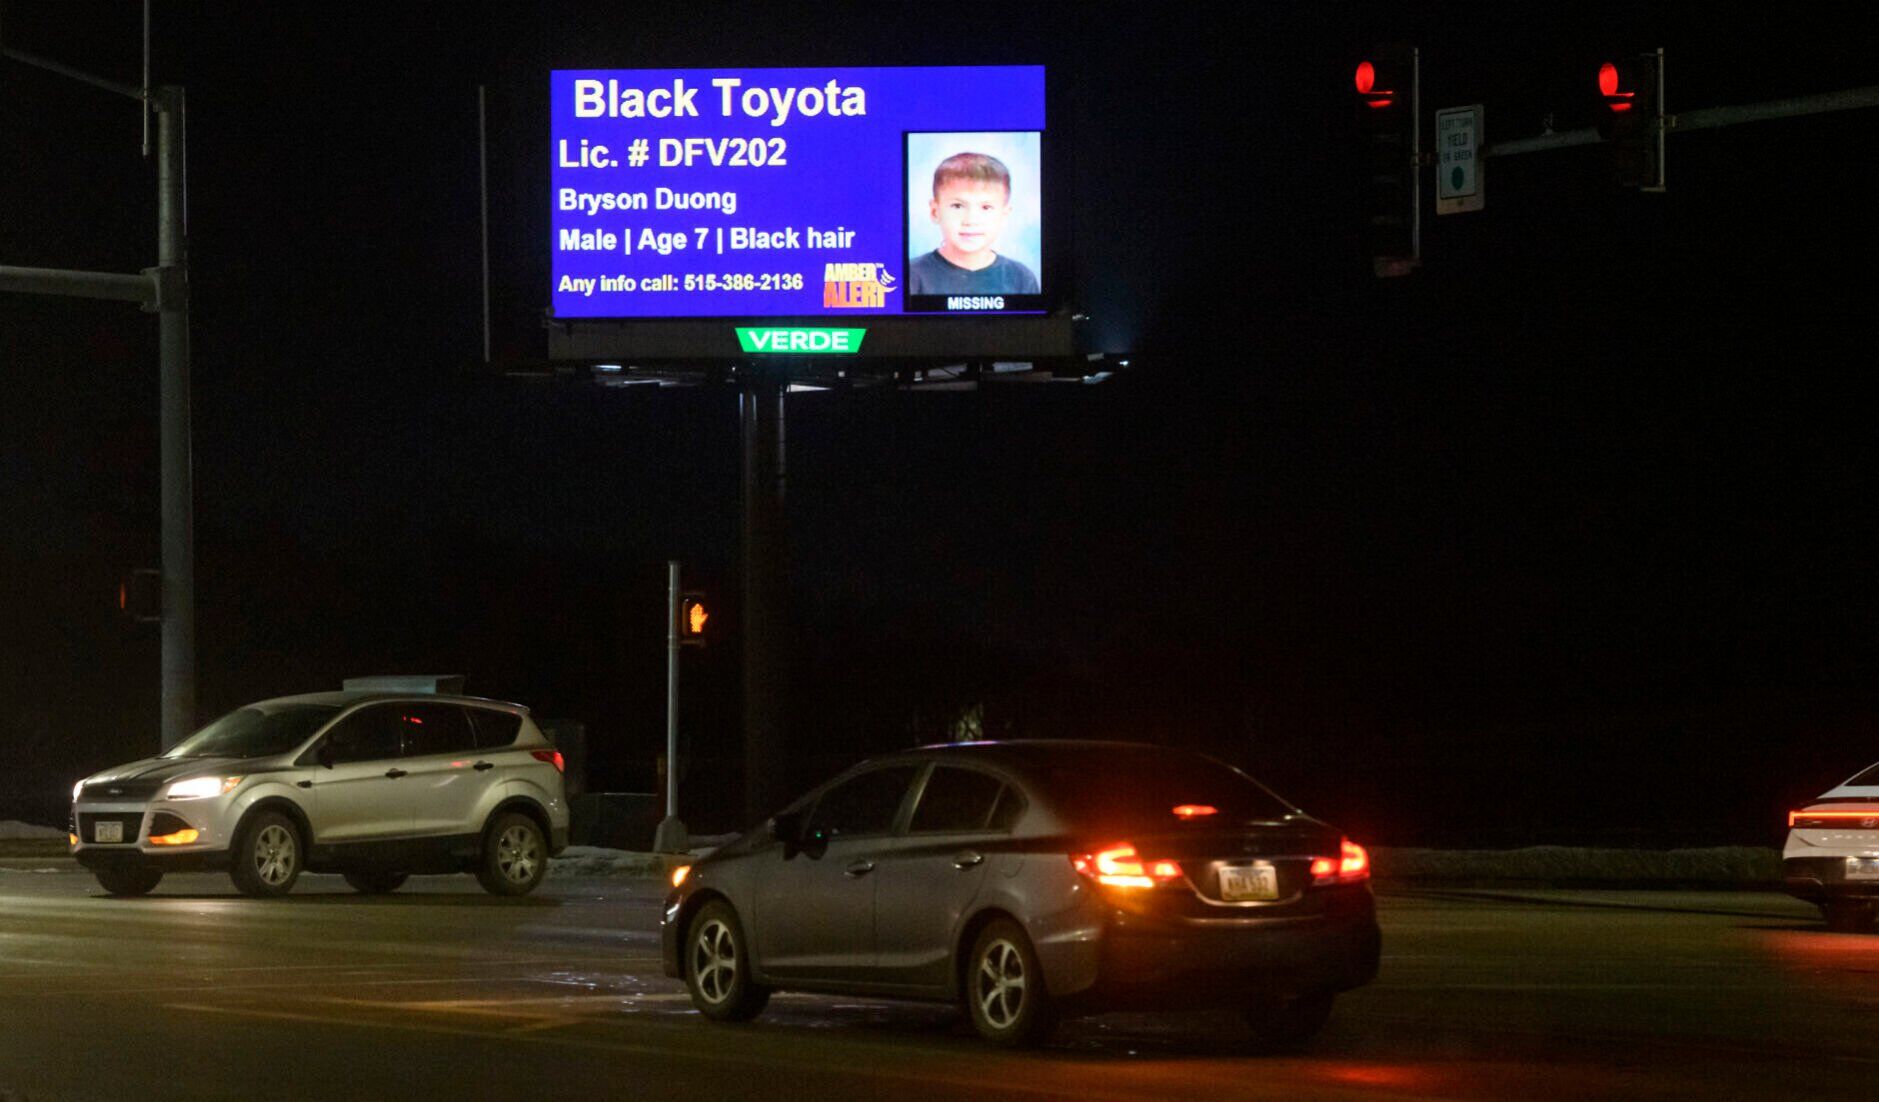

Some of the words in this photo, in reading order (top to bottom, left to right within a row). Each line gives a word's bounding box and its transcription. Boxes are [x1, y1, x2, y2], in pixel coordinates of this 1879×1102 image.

[574, 78, 699, 118] Black
[711, 78, 867, 127] Toyota
[559, 138, 618, 168] Lic.
[627, 138, 650, 167] #
[658, 137, 788, 168] DFV202
[559, 187, 648, 215] Bryson
[655, 187, 737, 214] Duong
[559, 228, 618, 251] Male
[637, 228, 688, 255] Age
[694, 227, 710, 250] 7
[730, 226, 801, 250] Black
[807, 226, 856, 249] hair
[558, 274, 596, 297] Any
[600, 274, 637, 292] info
[639, 274, 679, 292] call:
[683, 273, 804, 292] 515-386-2136
[824, 262, 877, 282] AMBER
[823, 281, 886, 308] ALERT
[946, 296, 1005, 310] MISSING
[748, 330, 850, 351] VERDE
